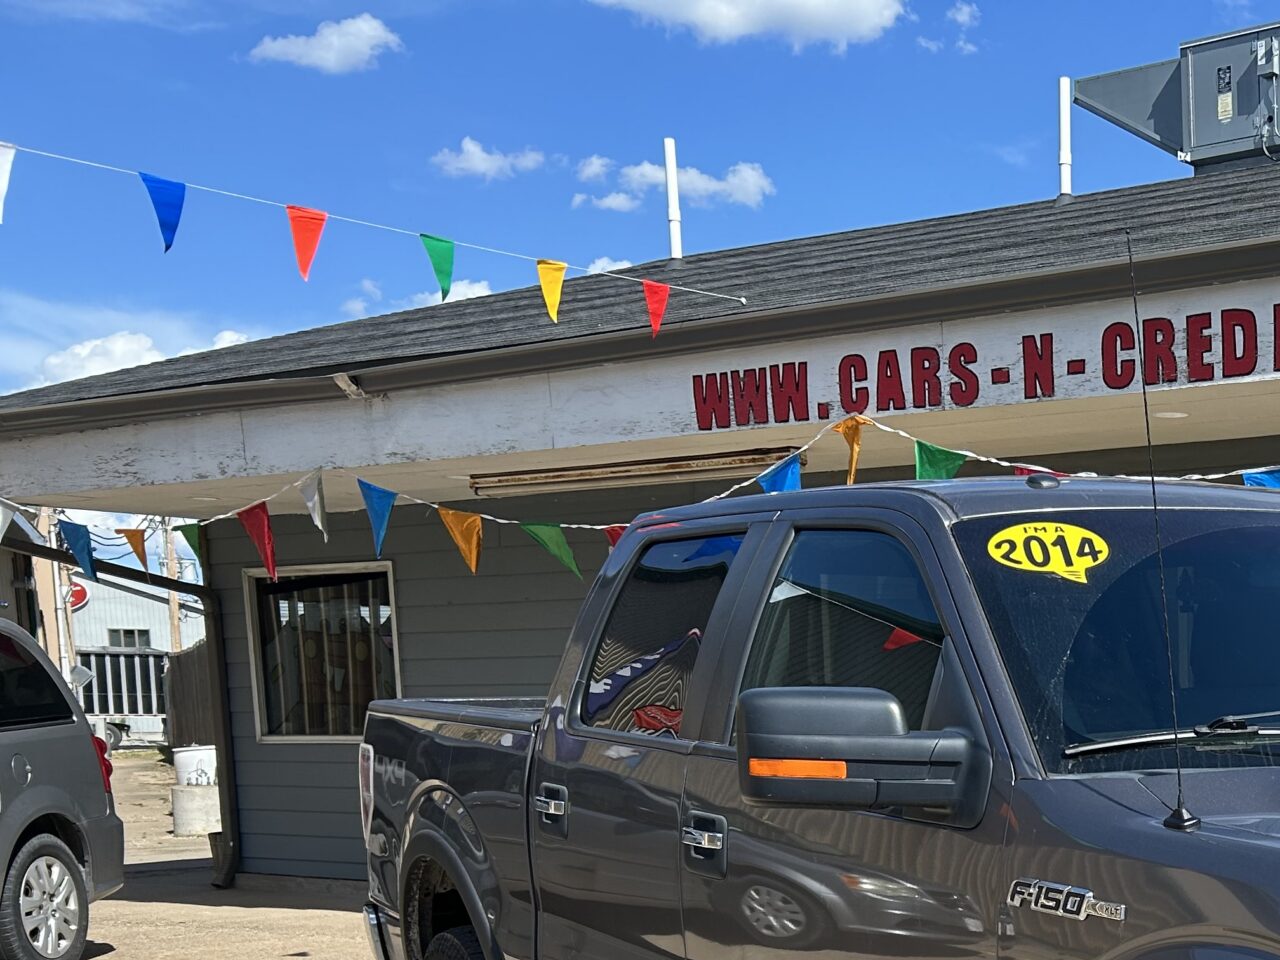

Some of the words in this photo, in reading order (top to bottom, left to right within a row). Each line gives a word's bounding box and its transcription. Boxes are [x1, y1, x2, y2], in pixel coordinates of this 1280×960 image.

[1022, 525, 1048, 535] I'M
[1054, 525, 1066, 534] A
[994, 534, 1103, 568] 2014
[1008, 880, 1086, 919] F-150
